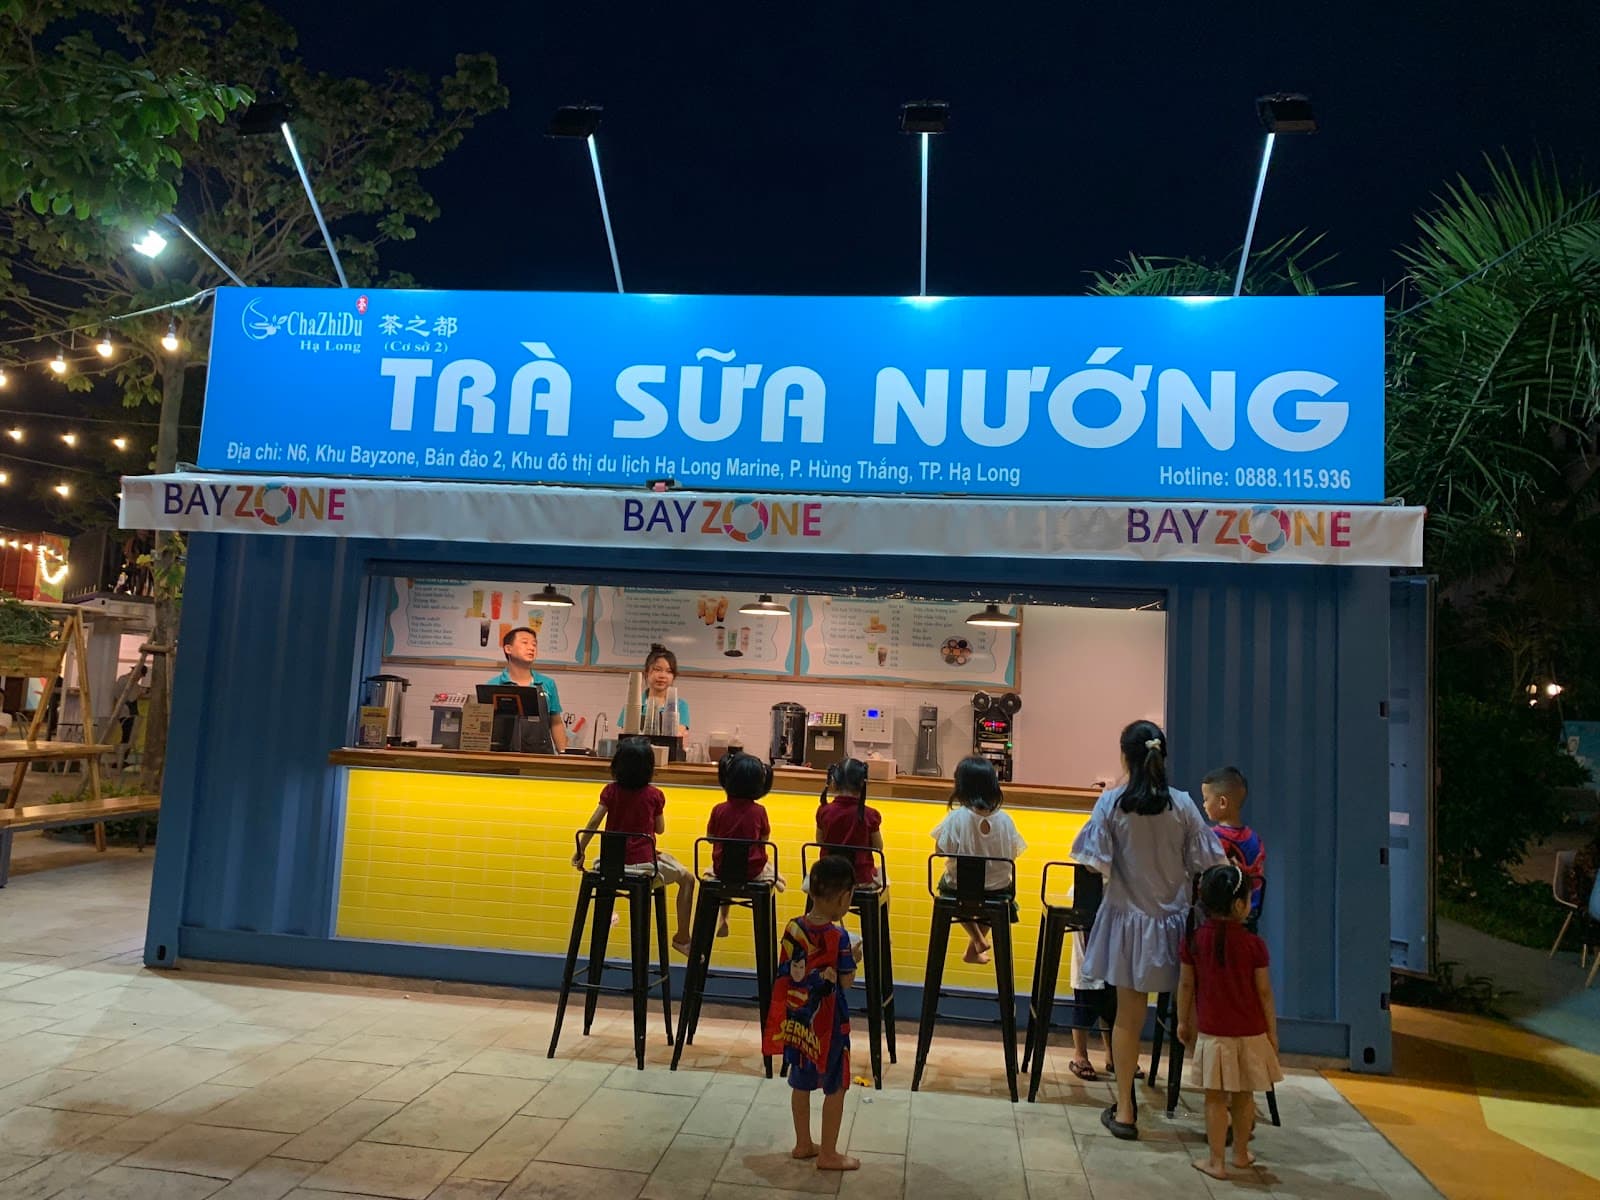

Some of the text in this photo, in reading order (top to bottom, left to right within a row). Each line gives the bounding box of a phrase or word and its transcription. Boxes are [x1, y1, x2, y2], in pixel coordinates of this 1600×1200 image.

[287, 311, 363, 337] ChaZhiDu
[378, 314, 459, 338] 茶之都
[300, 340, 361, 354] Hạ Long
[434, 341, 449, 354] 2)
[380, 341, 1350, 451] TRÀ SỮA NƯỚNG
[227, 441, 251, 464] Địa
[287, 443, 310, 464] N6,
[315, 444, 346, 463] Khu
[350, 445, 419, 468] Bayzone,
[425, 447, 455, 466] Bán
[492, 450, 506, 471] 2,
[511, 451, 543, 470] Khu
[547, 452, 567, 471] đô
[572, 453, 593, 476] thị
[597, 454, 617, 473] du
[621, 455, 650, 477] lịch
[655, 456, 675, 478] Hạ
[681, 457, 721, 480] Long
[726, 458, 784, 480] Marine,
[789, 459, 803, 477] P.
[808, 459, 851, 483] Hùng
[857, 457, 913, 484] Thắng,
[919, 461, 943, 481] TP.
[949, 462, 971, 485] Hạ
[977, 463, 1021, 486] Long
[1159, 466, 1351, 489] Hotline: 0888.115.936
[164, 482, 347, 527] BAYZONE
[623, 496, 822, 543] BAYZONE
[1127, 505, 1352, 554] BAYZONE
